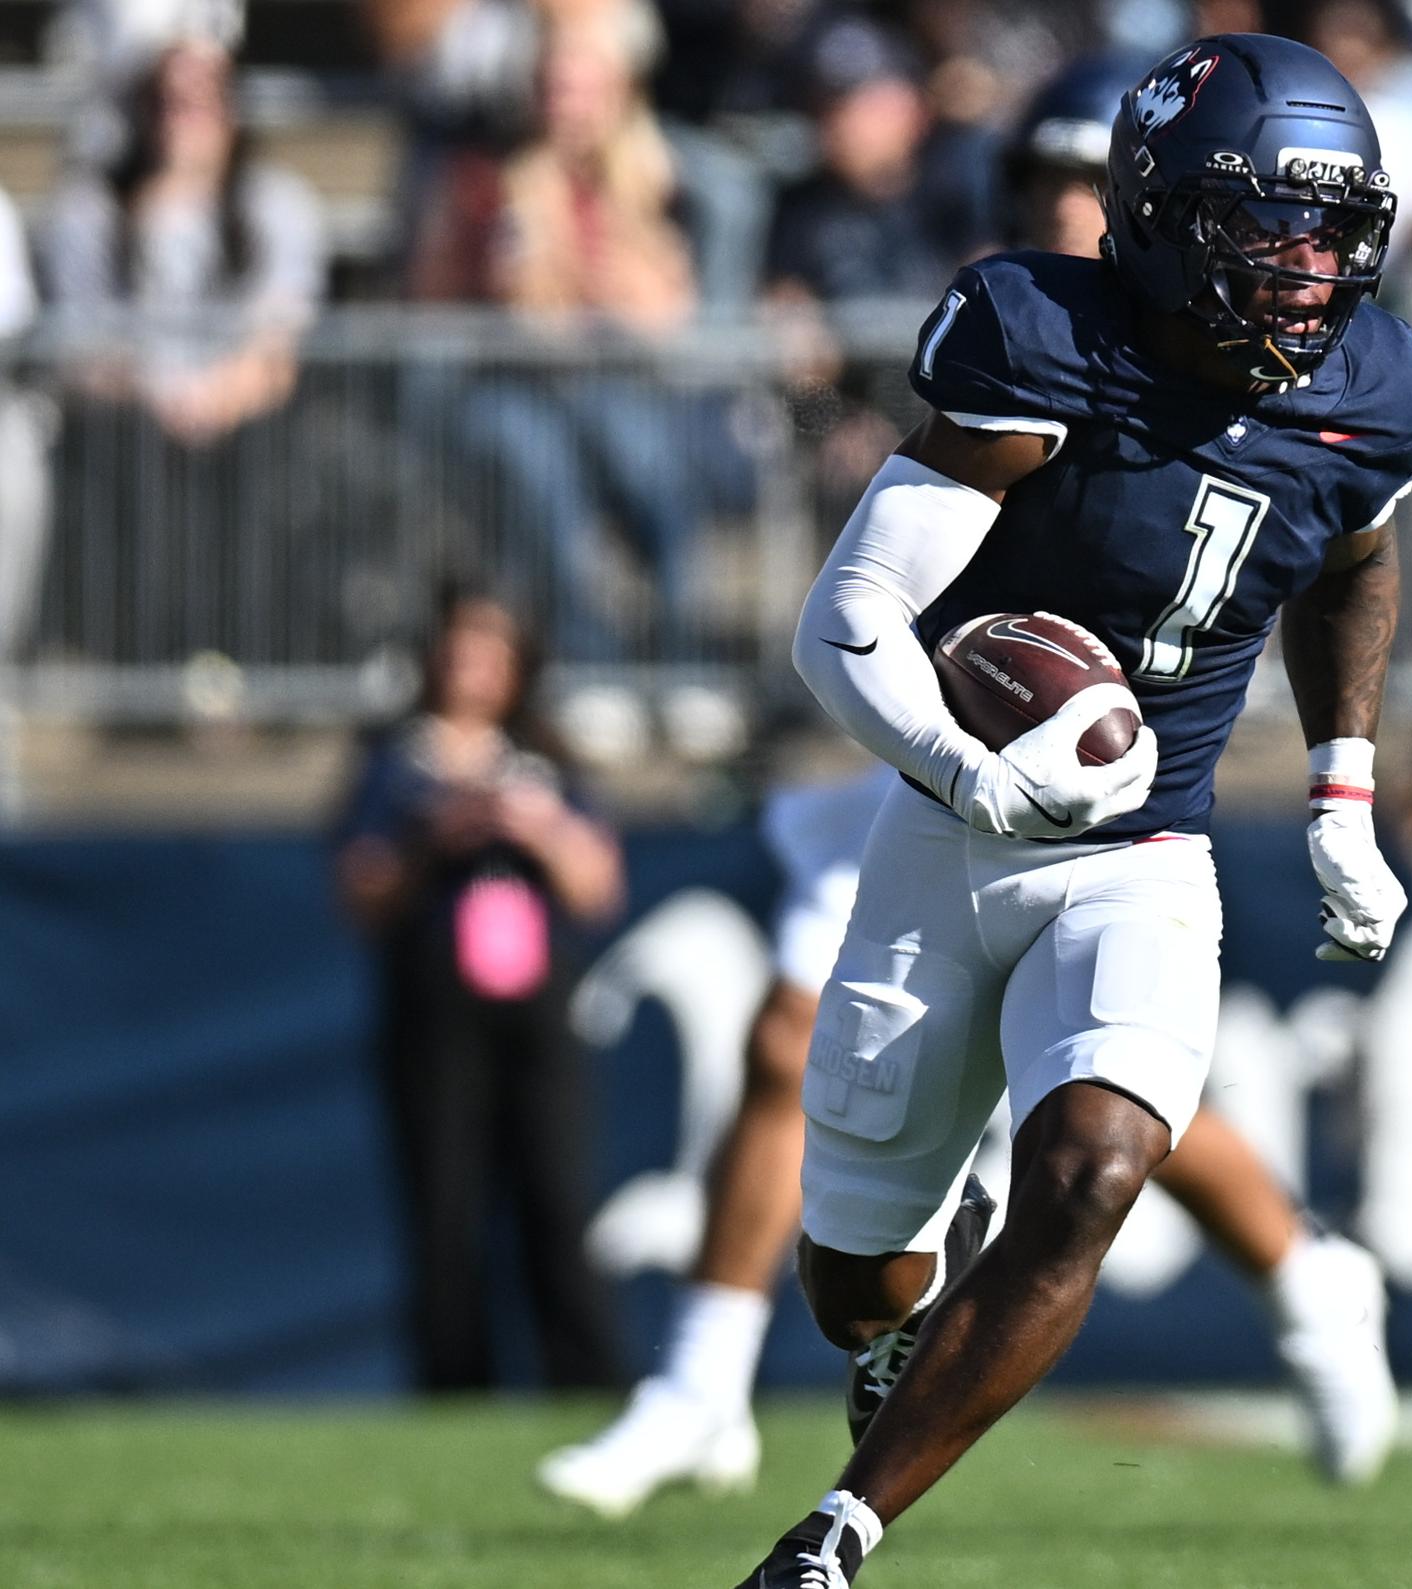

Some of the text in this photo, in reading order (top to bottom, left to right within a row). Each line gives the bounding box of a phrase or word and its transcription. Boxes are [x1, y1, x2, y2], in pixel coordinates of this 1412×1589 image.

[1205, 161, 1250, 175] OAKLEY
[919, 289, 966, 380] 1
[1136, 474, 1270, 682] 1
[997, 671, 1034, 703] ELITE
[808, 1033, 898, 1095] HOSEN
